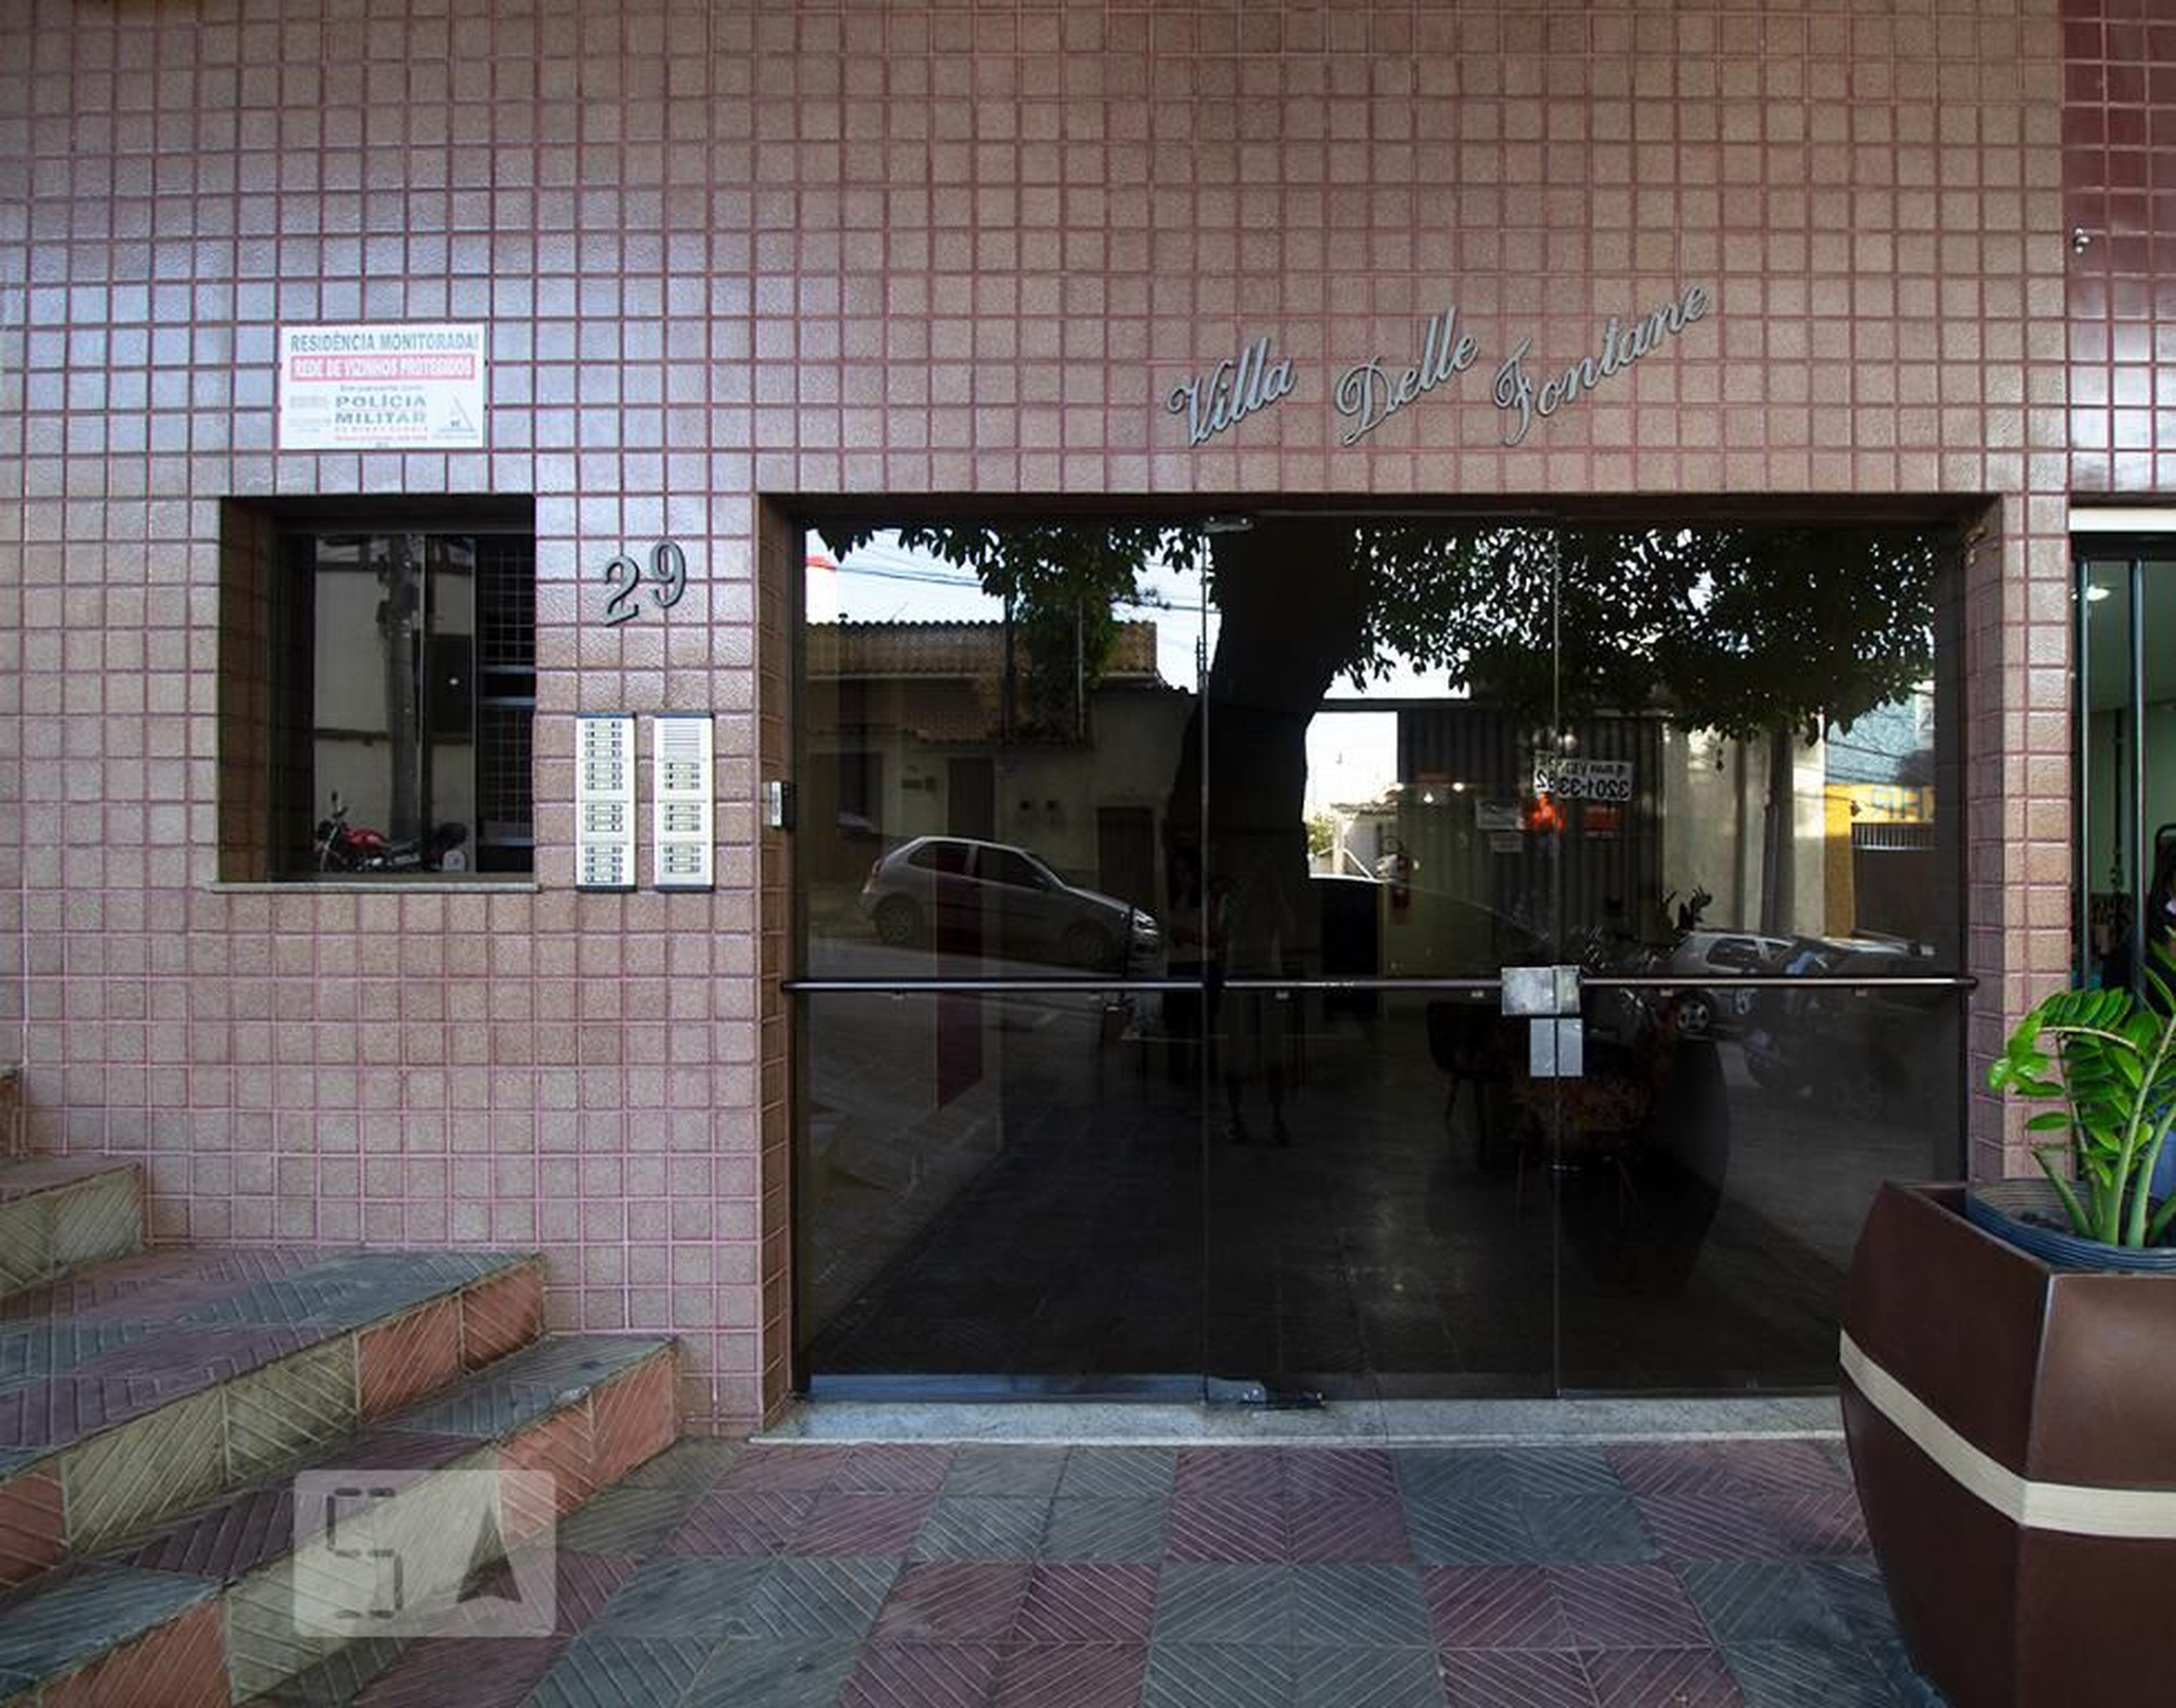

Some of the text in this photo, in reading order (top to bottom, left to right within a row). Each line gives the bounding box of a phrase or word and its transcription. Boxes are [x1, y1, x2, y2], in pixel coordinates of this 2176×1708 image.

[291, 331, 375, 352] RESIDÊNCIA
[1166, 283, 1708, 447] Villa Delle Fontane
[335, 394, 427, 407] POLÍCIA
[335, 412, 427, 424] MILITAR
[603, 538, 687, 627] 29
